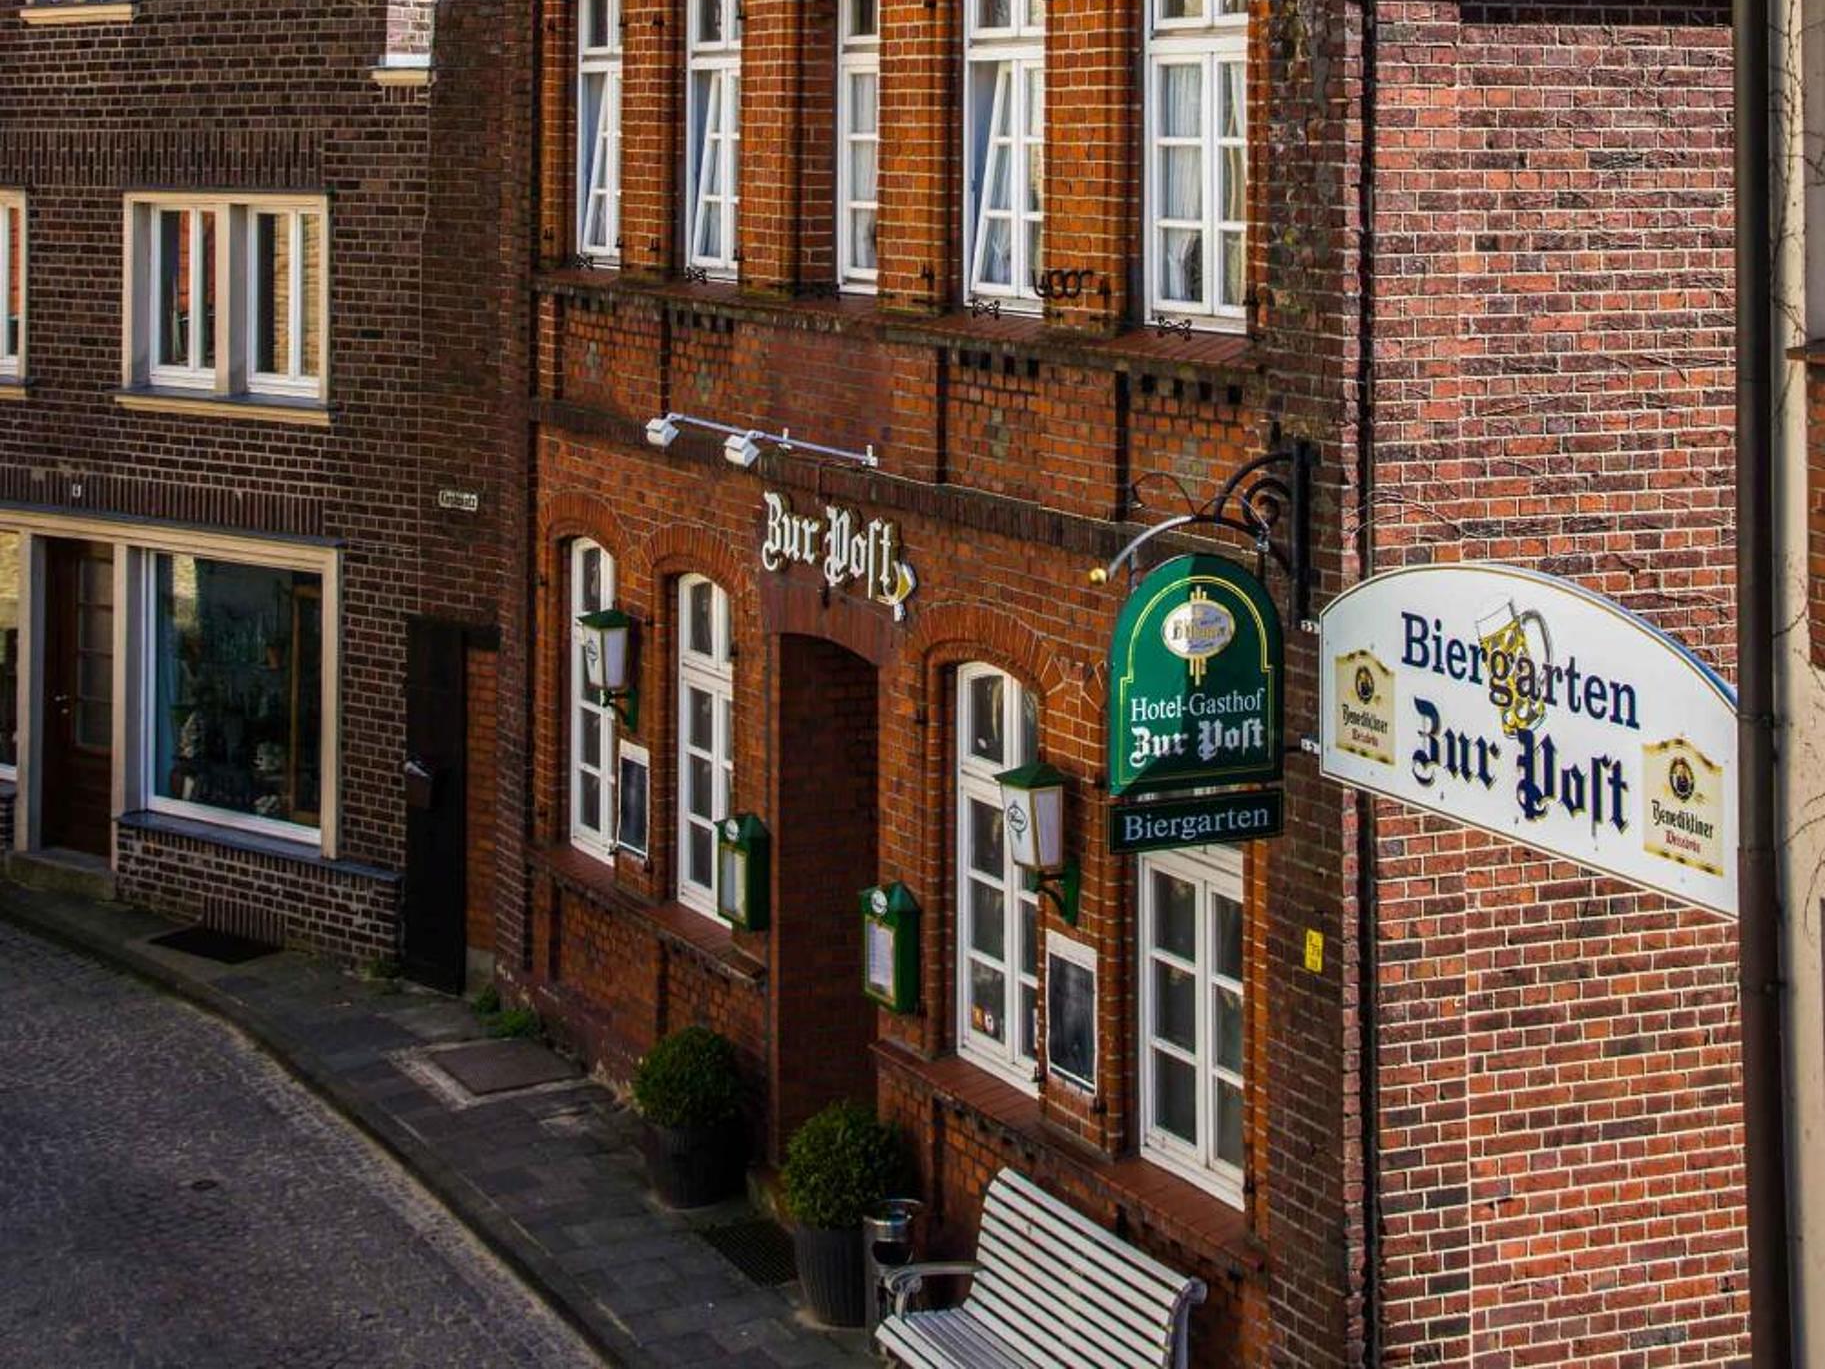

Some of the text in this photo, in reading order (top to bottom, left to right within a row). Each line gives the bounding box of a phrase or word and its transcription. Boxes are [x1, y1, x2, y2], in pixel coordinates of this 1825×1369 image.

[762, 490, 893, 599] Zur Post
[1130, 687, 1265, 722] Hotel-Gasthof
[1401, 611, 1640, 730] Biergarten
[1129, 717, 1265, 768] Zur Post
[1412, 695, 1630, 842] Zur Post
[1123, 806, 1269, 841] Biergarten
